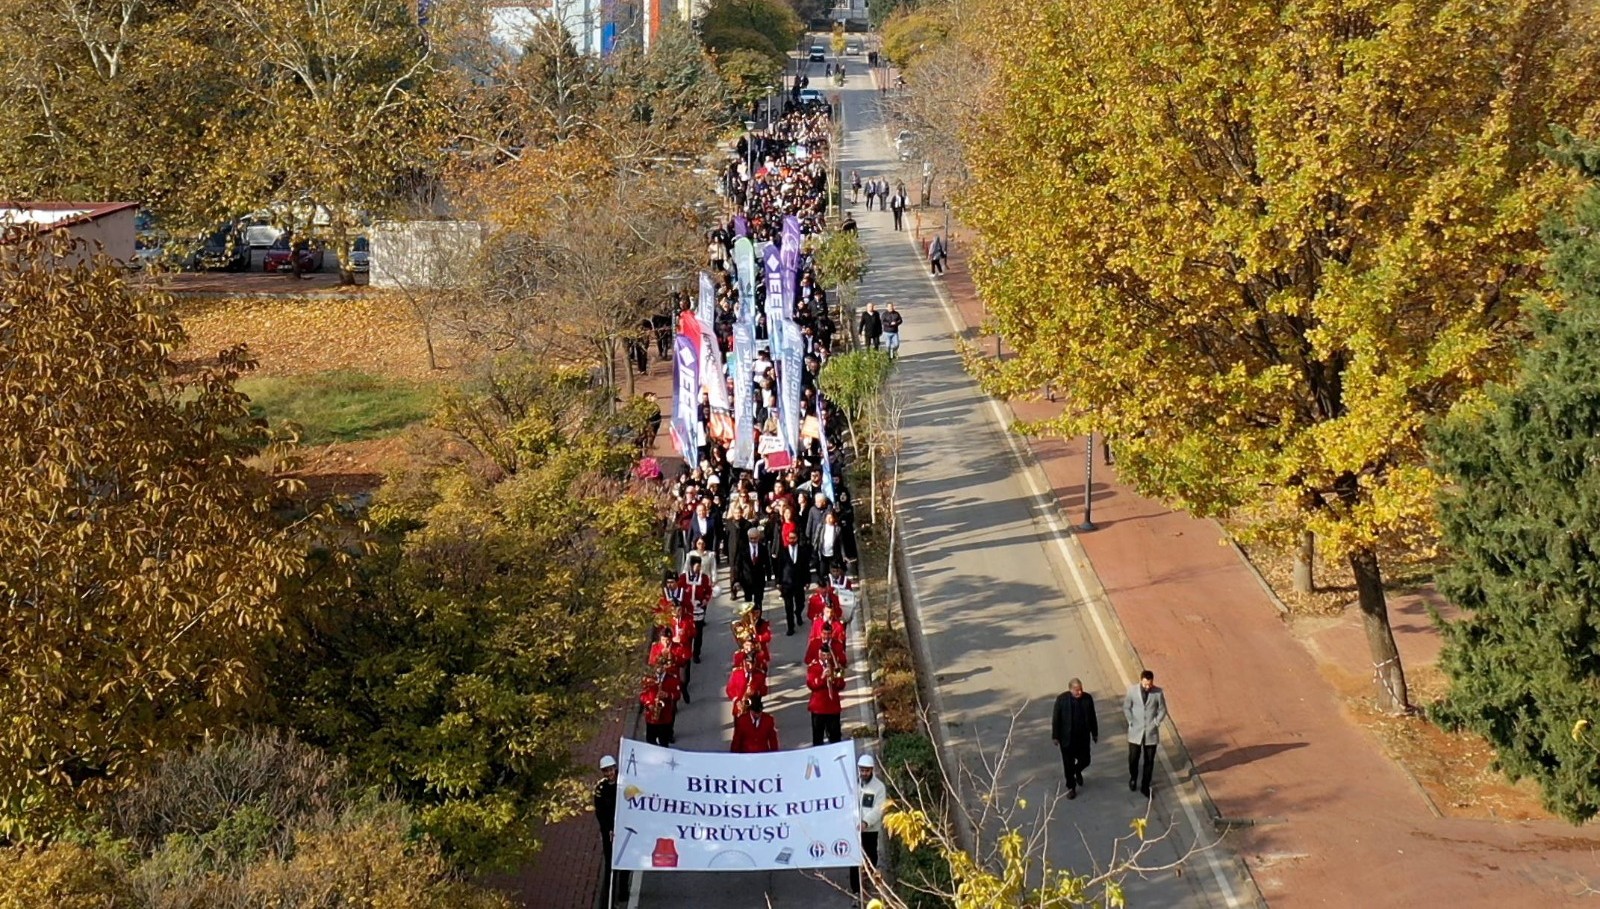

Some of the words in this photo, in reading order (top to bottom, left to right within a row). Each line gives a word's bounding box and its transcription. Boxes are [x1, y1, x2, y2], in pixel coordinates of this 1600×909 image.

[768, 273, 783, 320] IEEE
[687, 773, 783, 794] BİRİNCİ
[628, 794, 779, 819] MÜHENDİSLİK
[786, 795, 846, 816] RUHU
[676, 822, 791, 843] YÜRÜYÜŞÜ
